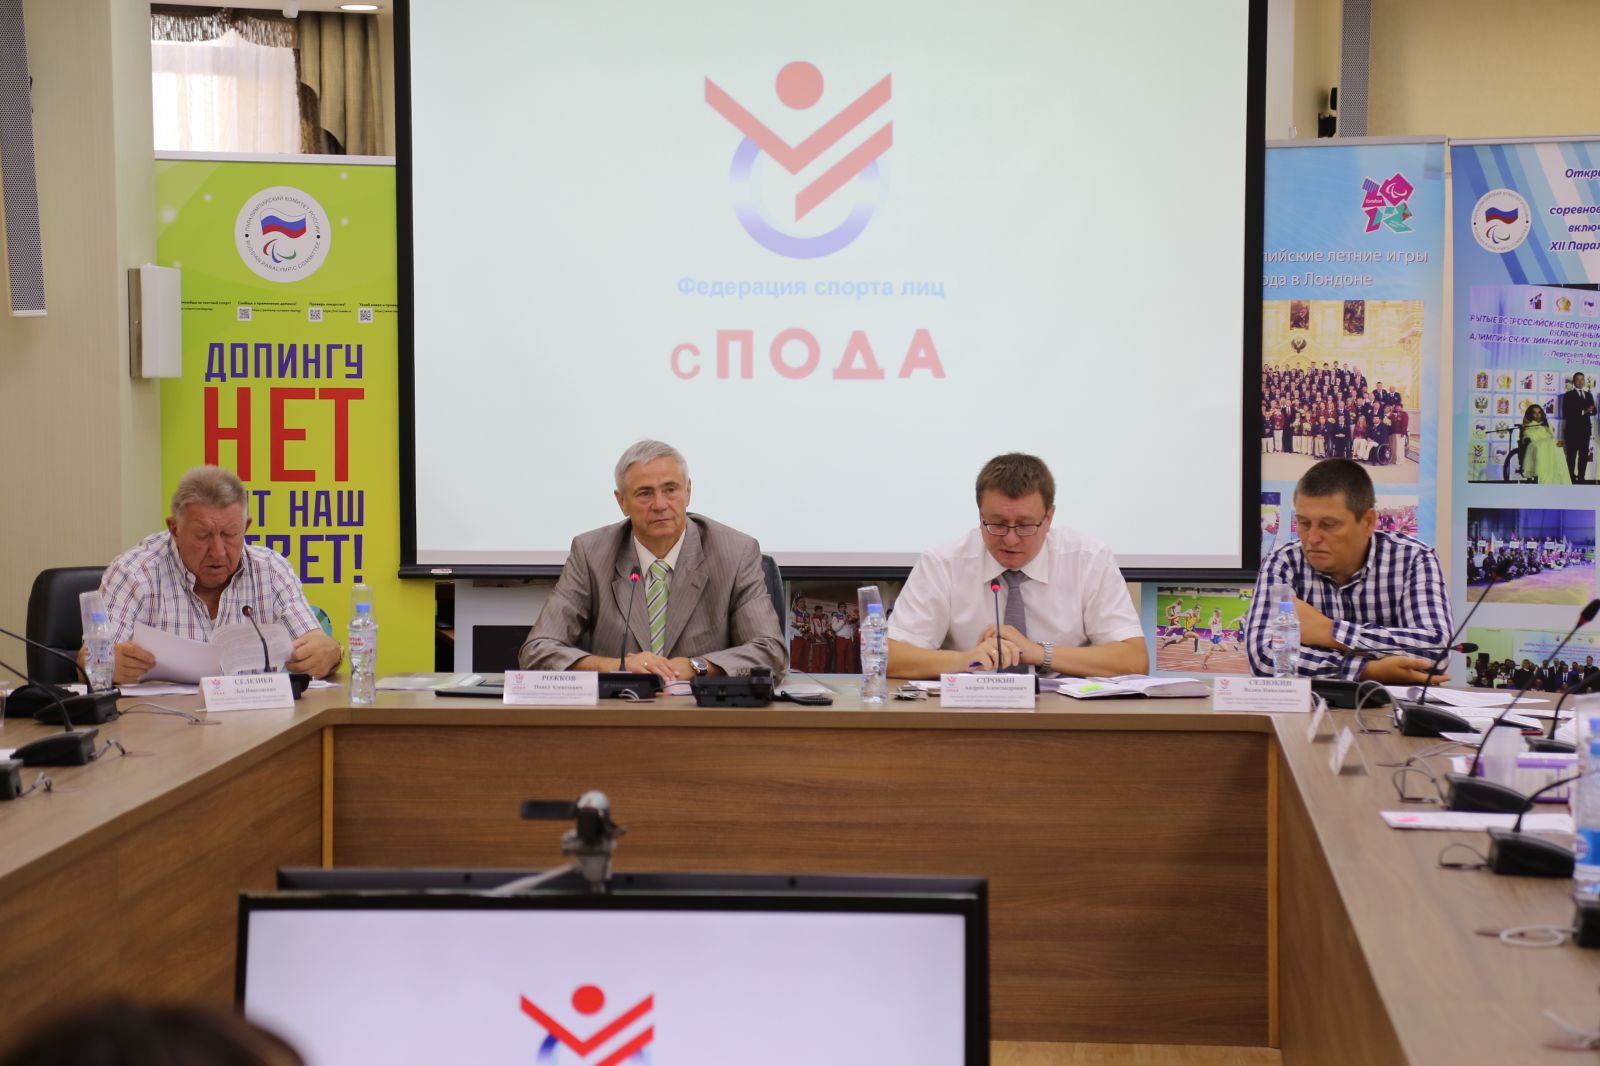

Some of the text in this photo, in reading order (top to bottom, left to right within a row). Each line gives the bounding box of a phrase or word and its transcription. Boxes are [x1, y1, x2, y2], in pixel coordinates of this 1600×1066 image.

[1565, 168, 1600, 179] Откр
[1327, 250, 1383, 263] летние
[1386, 250, 1428, 265] игры
[677, 276, 946, 300] Федерация спорта лиц
[1291, 275, 1300, 286] в
[1303, 271, 1373, 288] Лондоне
[205, 342, 363, 382] ДОПИНГУ
[204, 387, 364, 482] НЕТ
[289, 490, 364, 527] НАШ
